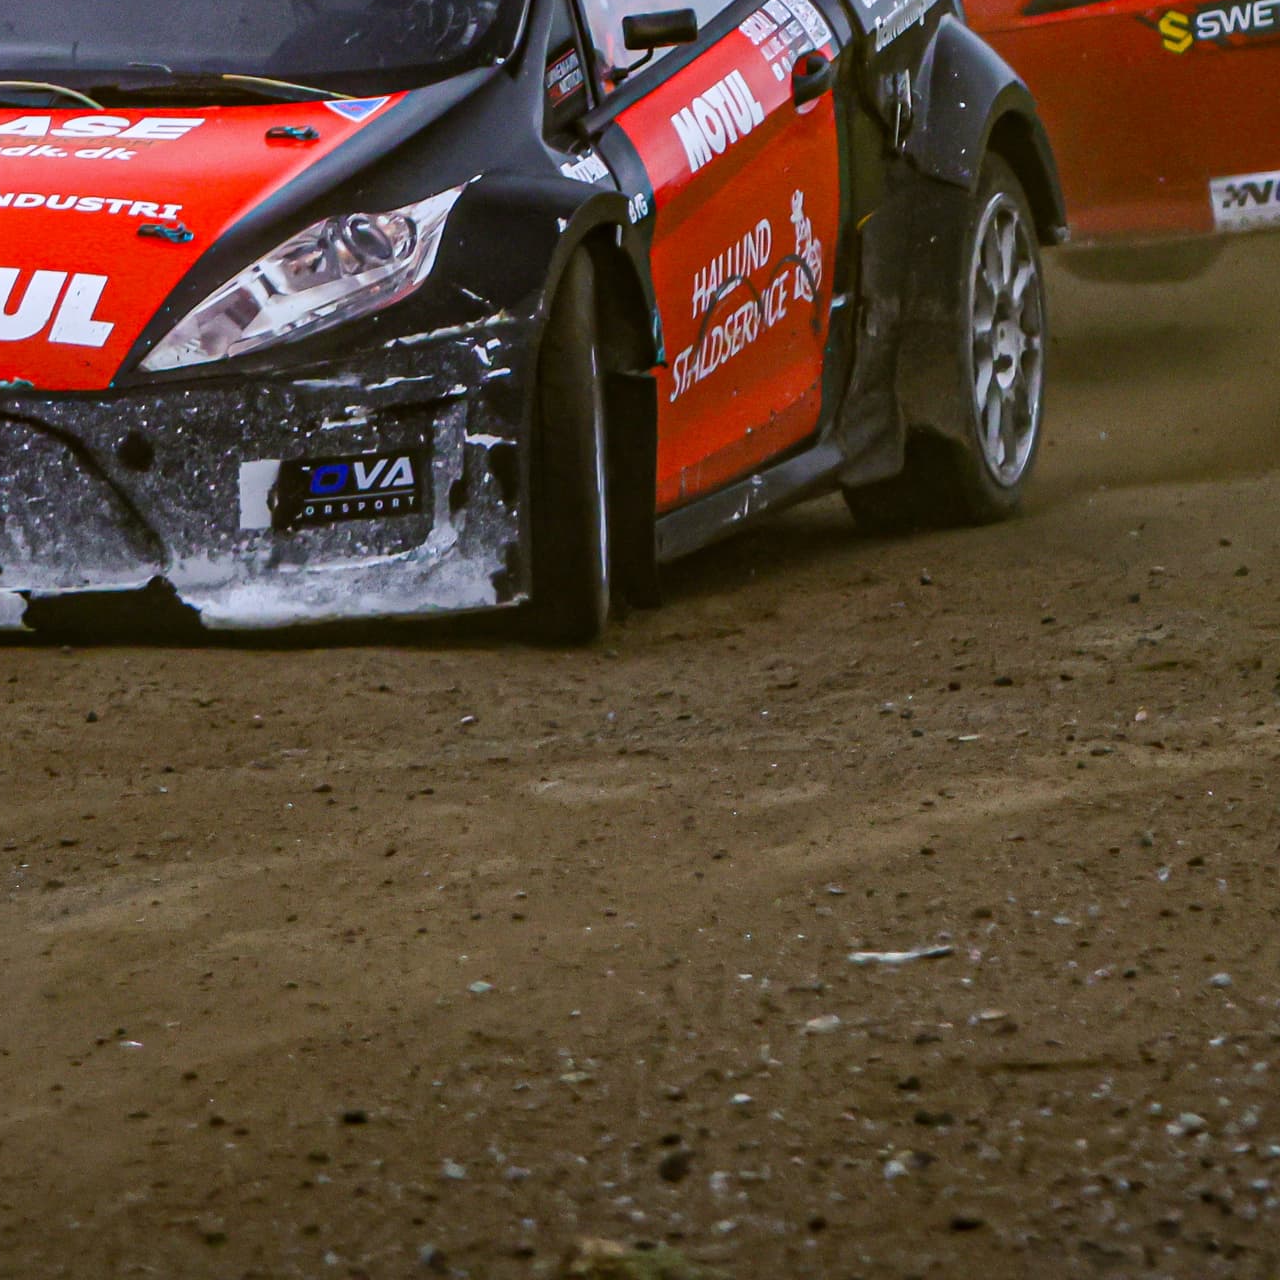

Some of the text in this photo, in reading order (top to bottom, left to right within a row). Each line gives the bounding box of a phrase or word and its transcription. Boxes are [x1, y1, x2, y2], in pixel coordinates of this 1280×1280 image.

[671, 68, 766, 175] MOTUL
[692, 218, 772, 320] HALLUND
[670, 270, 790, 403] STALDSERVICE
[305, 456, 415, 495] OVA
[305, 495, 415, 516] ORSPORT
